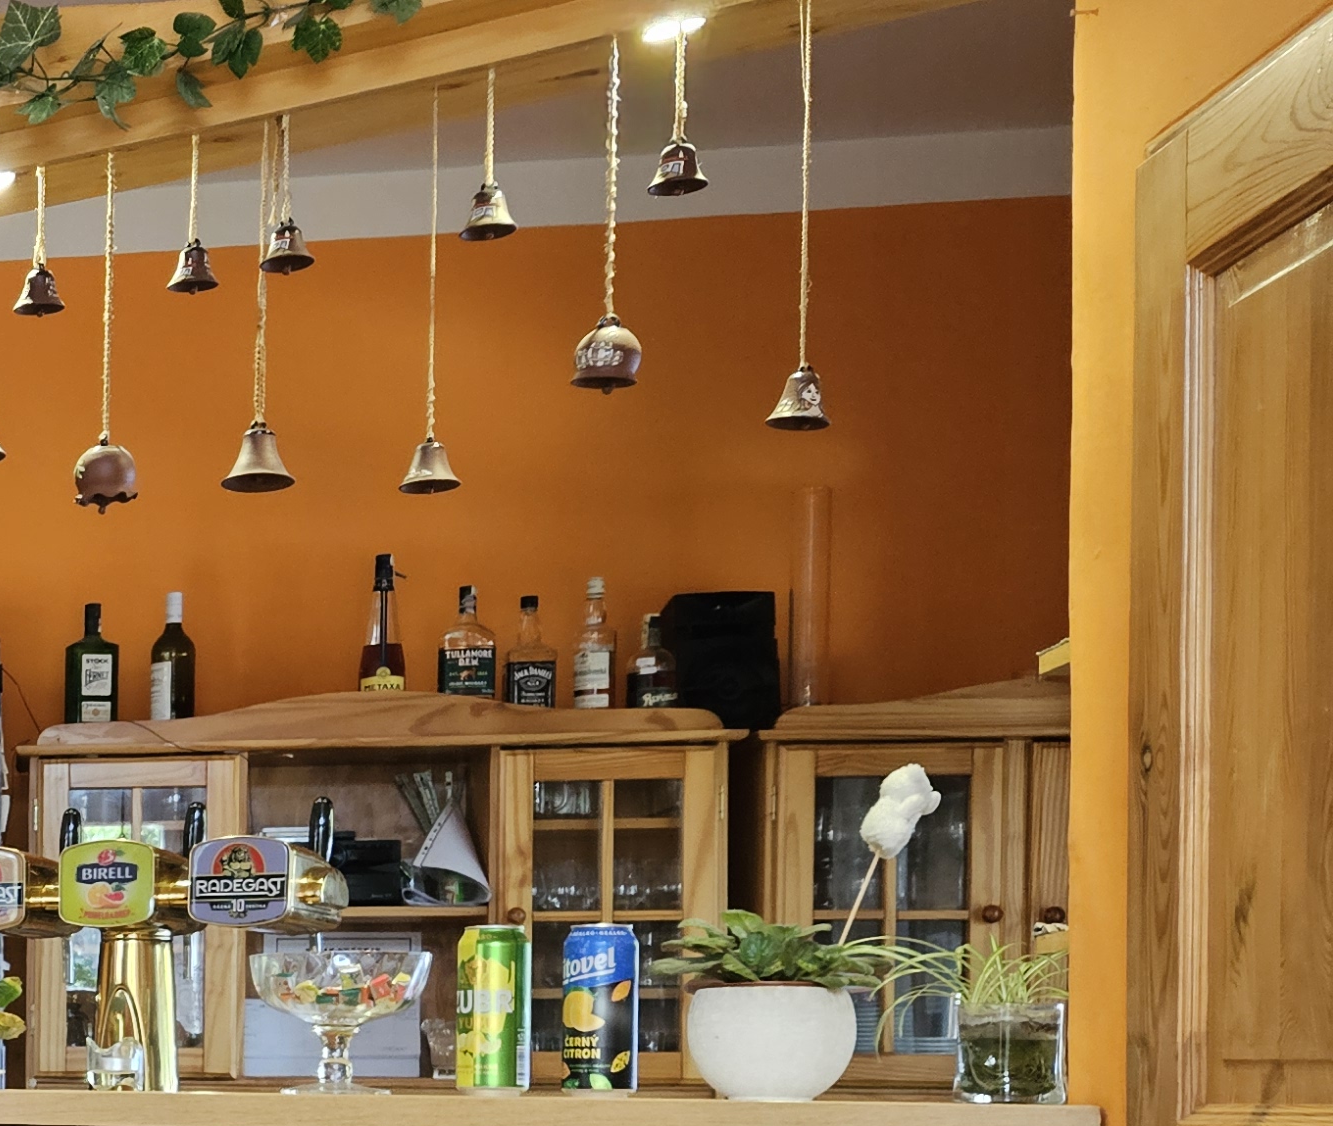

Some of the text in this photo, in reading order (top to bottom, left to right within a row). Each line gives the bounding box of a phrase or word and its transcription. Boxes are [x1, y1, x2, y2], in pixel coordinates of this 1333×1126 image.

[445, 649, 492, 659] TULLAMORE
[364, 683, 401, 692] METAXA
[81, 866, 133, 880] BIRELL
[196, 877, 285, 897] RADEGAST
[231, 899, 245, 912] 10
[562, 946, 617, 979] itovel
[564, 1034, 599, 1047] ČERNÝ
[563, 1048, 601, 1059] CITRON
